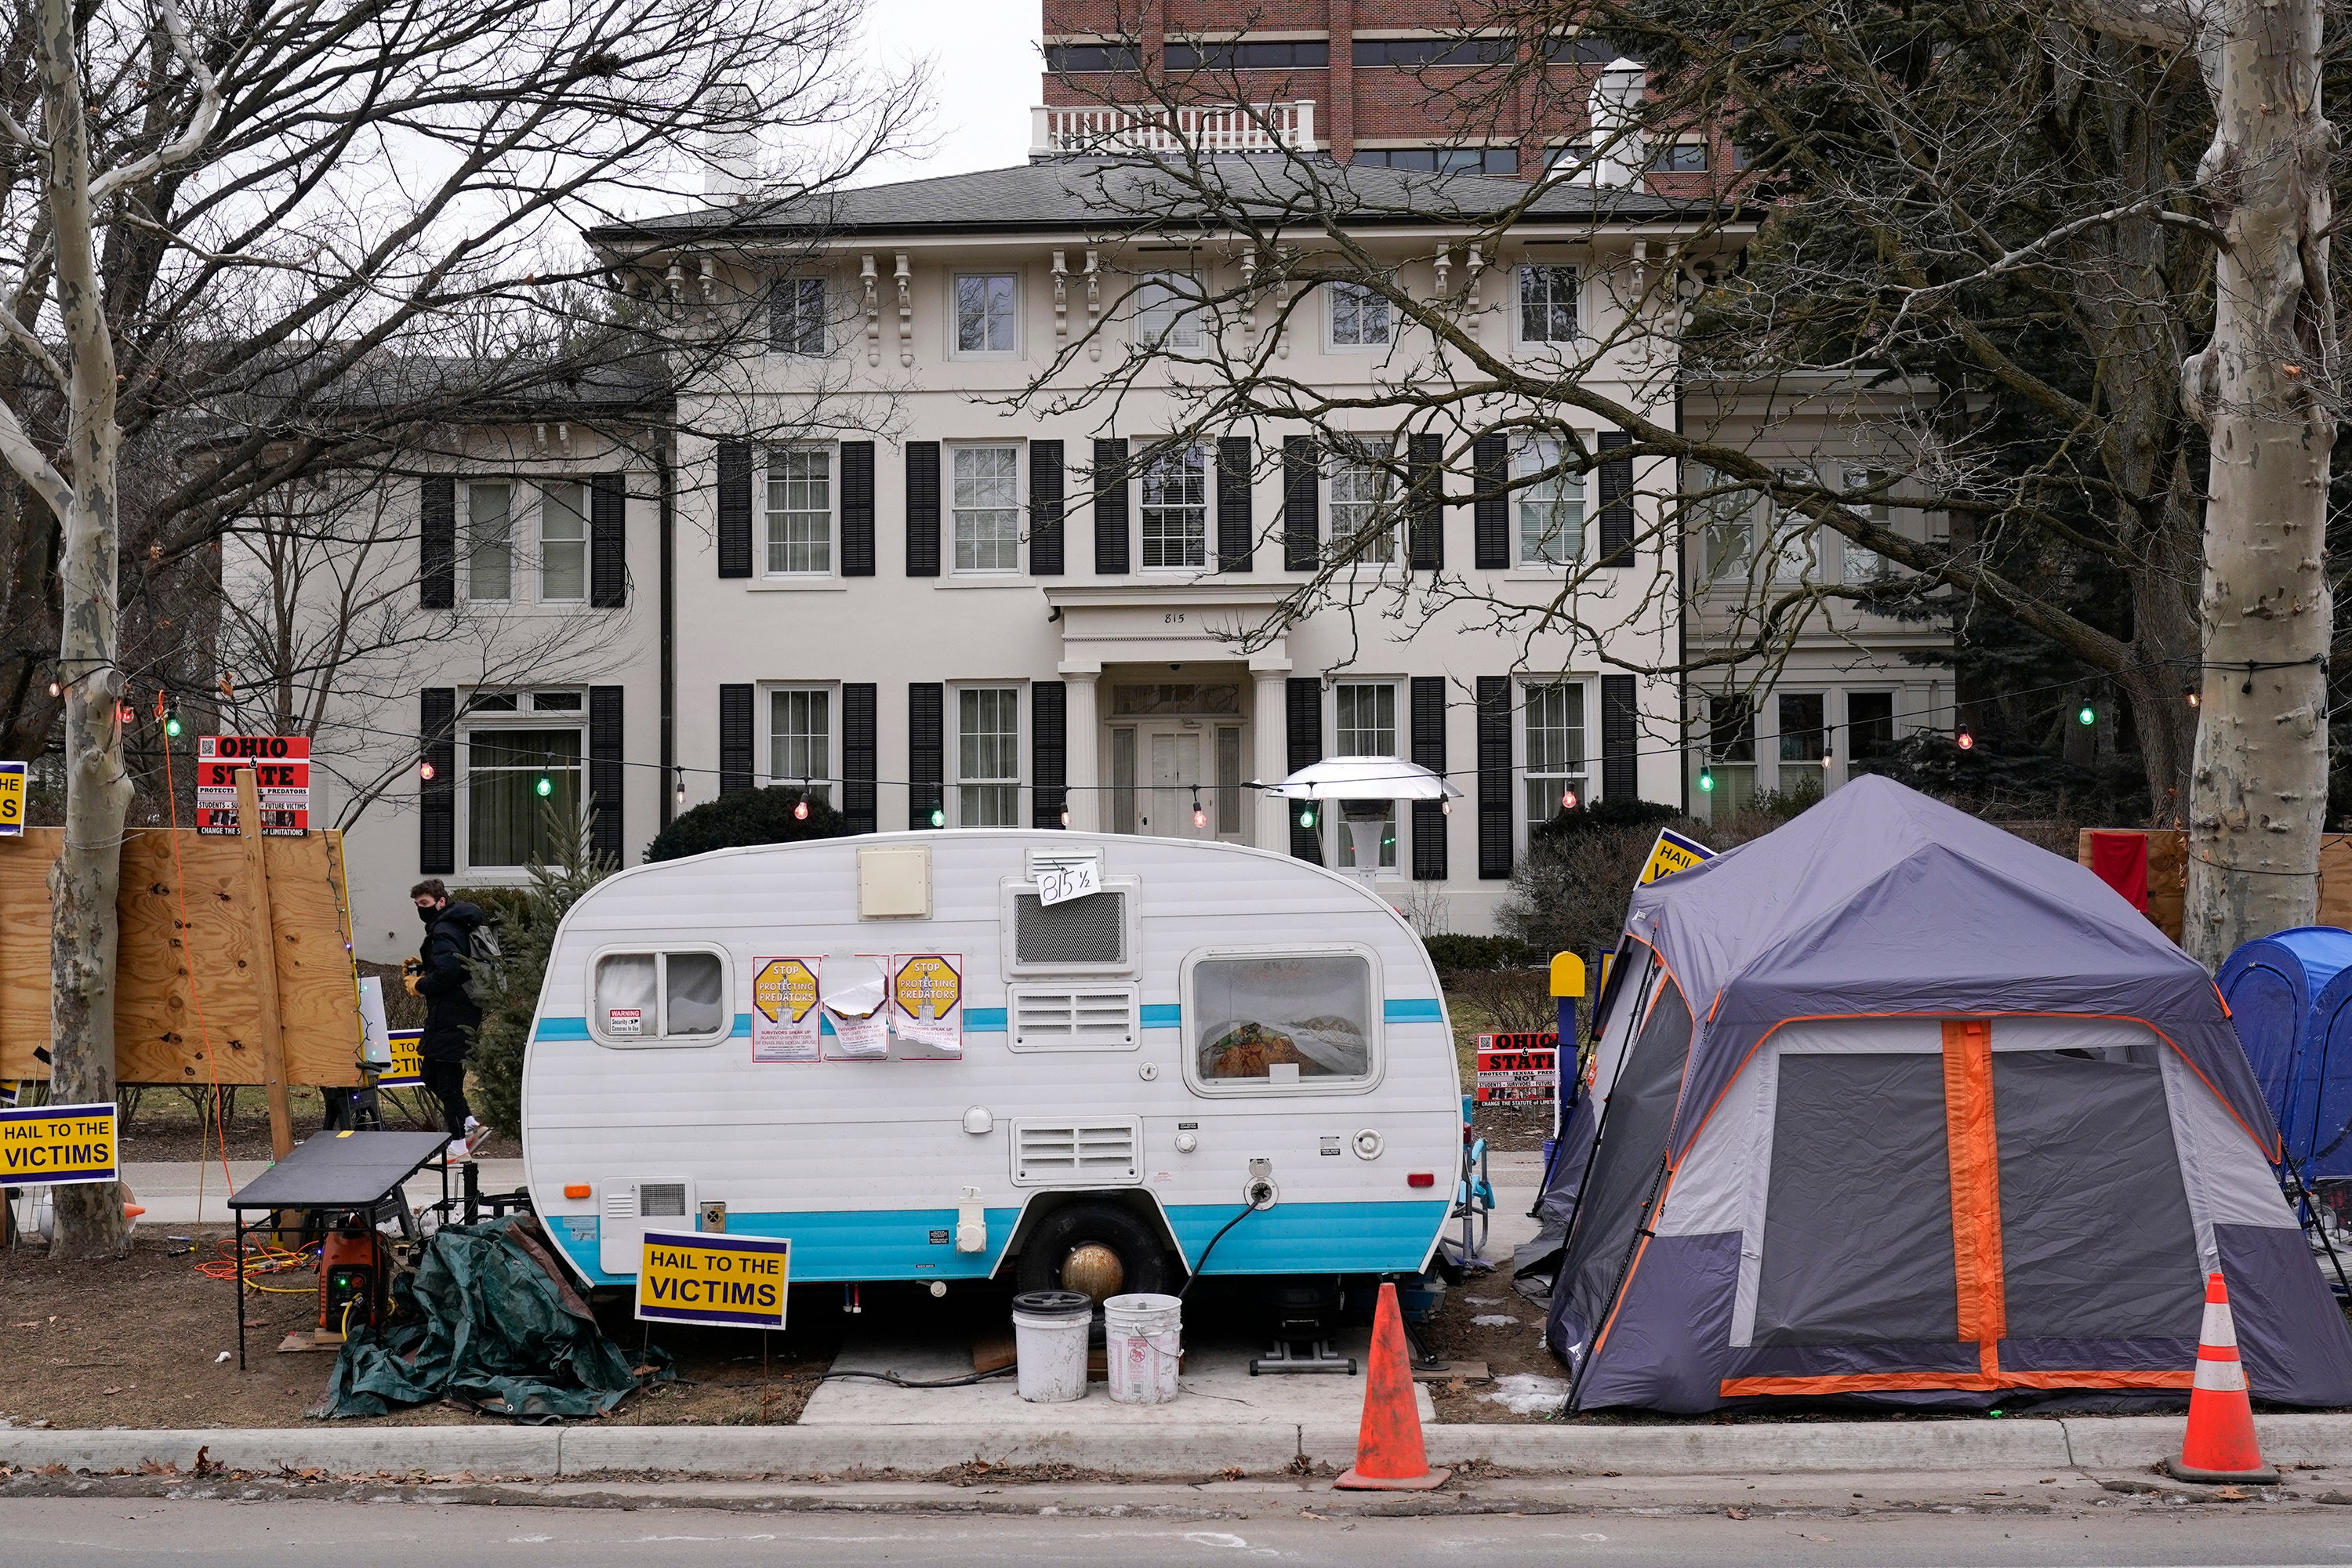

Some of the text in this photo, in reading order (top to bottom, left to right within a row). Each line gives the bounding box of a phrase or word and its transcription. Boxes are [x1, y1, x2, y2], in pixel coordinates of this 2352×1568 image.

[1164, 613, 1185, 623] 815
[220, 738, 289, 757] OHIO
[249, 756, 257, 768] &
[212, 765, 294, 785] STTE
[0, 779, 20, 791] HE
[1044, 870, 1074, 901] 815
[773, 966, 799, 975] STOP
[914, 963, 940, 971] STOP
[759, 982, 814, 991] PROTECTING
[900, 979, 955, 988] PROTECTING
[759, 993, 814, 1002] PREDATORS
[900, 990, 955, 999] PREDATORS
[399, 1043, 415, 1052] TO
[5, 1122, 109, 1139] HAIL TO THE
[5, 1143, 109, 1167] VICTIMS
[651, 1251, 779, 1274] HAIL TO THE
[649, 1276, 776, 1306] VICTIMS
